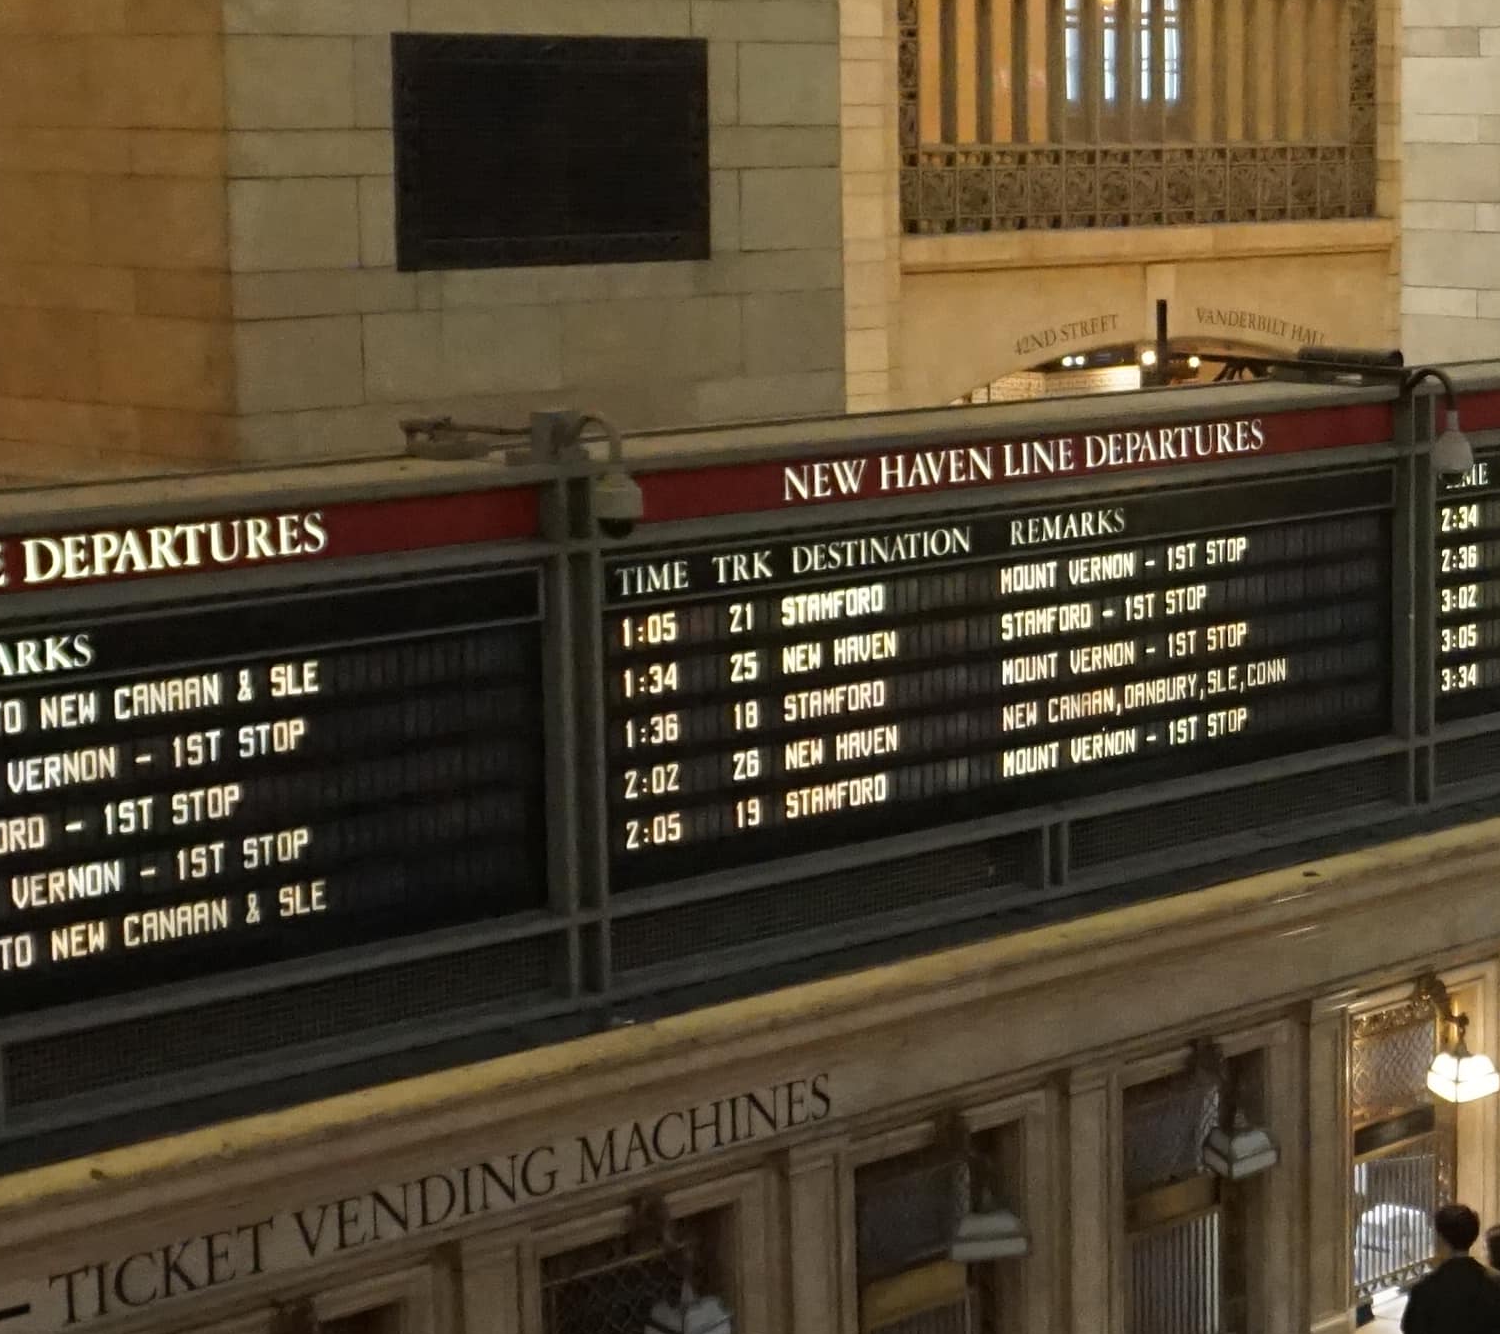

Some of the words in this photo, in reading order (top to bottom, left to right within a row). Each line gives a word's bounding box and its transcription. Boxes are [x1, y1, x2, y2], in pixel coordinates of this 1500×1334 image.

[1014, 328, 1057, 355] 42ND
[1060, 314, 1119, 343] STREET
[1196, 307, 1288, 338] VANDERBILT
[785, 460, 865, 500] NEW
[881, 447, 991, 489] HAVEN
[1004, 440, 1074, 476] LINE
[1086, 420, 1263, 467] DEPARTURES
[22, 512, 324, 582] DEPARTURES
[616, 562, 688, 595] TIME
[713, 551, 772, 582] TRK
[793, 528, 969, 573] DESTINATION
[1012, 509, 1124, 545] REMARKS
[1442, 505, 1478, 531] 2:34
[623, 613, 676, 646] 1:05
[730, 603, 752, 632] 21
[782, 585, 883, 625] STAMFORD
[1001, 562, 1057, 594] MOUNT
[1069, 552, 1134, 584] VERNON
[1168, 543, 1196, 571] 1ST
[1207, 537, 1246, 564] STOP
[1442, 545, 1478, 571] 2:36
[1442, 585, 1476, 611] 3:02
[625, 663, 677, 697] 1:34
[731, 652, 757, 682] 25
[783, 643, 821, 674] NEW
[834, 631, 896, 665] HAVEN
[1002, 603, 1091, 640] STAMFORD
[1126, 593, 1155, 620] 1ST
[1166, 585, 1206, 614] STOP
[1442, 624, 1477, 651] 3:05
[41, 692, 95, 729] NEW
[115, 674, 220, 719] CANAAN
[271, 662, 318, 696] SLE
[627, 714, 678, 747] 1:36
[735, 701, 758, 730] 18
[785, 681, 884, 721] STAMFORD
[1003, 653, 1057, 685] MOUNT
[1070, 641, 1134, 674] VERNON
[1169, 630, 1196, 657] 1ST
[1208, 623, 1246, 651] STOP
[1442, 664, 1476, 691] 3:34
[8, 747, 115, 793] VERNON
[174, 730, 220, 767] 1ST
[239, 719, 304, 757] STOP
[625, 764, 679, 798] 2:02
[734, 750, 759, 780] 26
[786, 739, 823, 770] NEW
[836, 726, 897, 761] HAVEN
[1003, 702, 1037, 731] NEW
[627, 813, 681, 849] 2:05
[737, 799, 760, 827] 19
[787, 774, 886, 818] STAMFORD
[1004, 742, 1059, 777] MOUNT
[1071, 729, 1135, 763] VERNON
[1169, 716, 1197, 745] 1ST
[1208, 708, 1247, 737] STOP
[105, 798, 152, 834] 1ST
[172, 785, 239, 824] STOP
[12, 861, 120, 909] VERNON
[178, 843, 224, 880] 1ST
[243, 829, 308, 868] STOP
[52, 922, 105, 960] NEW
[124, 899, 227, 946] CANAAN
[279, 882, 326, 916] SLE
[47, 1217, 275, 1328] TICKET
[291, 1145, 558, 1257] VENDING
[576, 1072, 831, 1186] MACHINES
